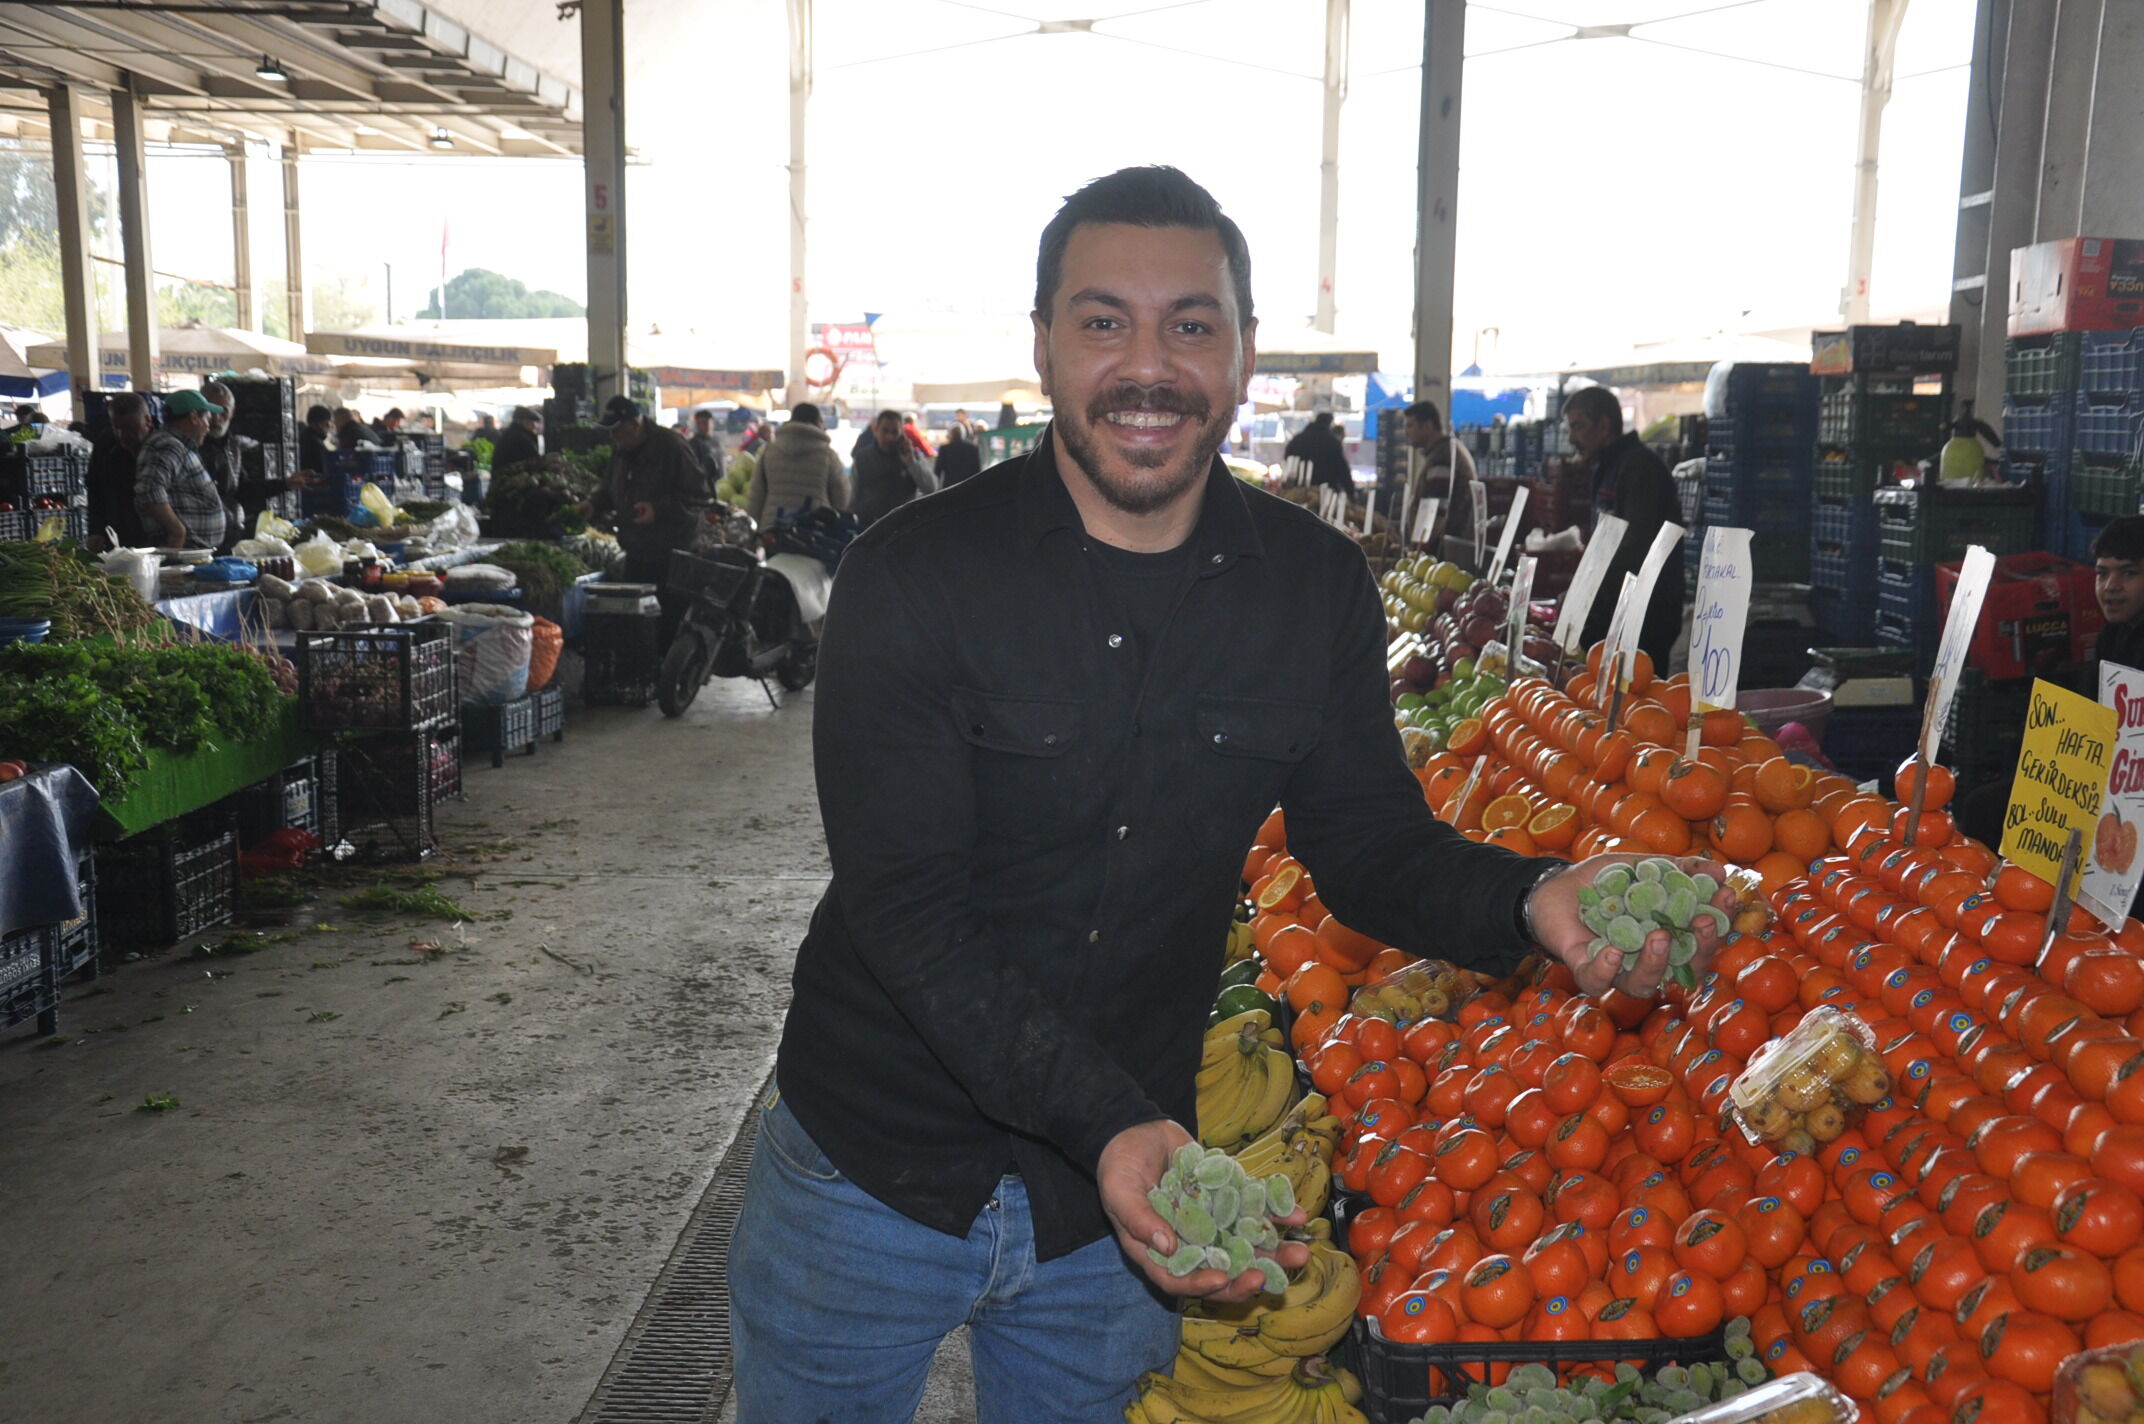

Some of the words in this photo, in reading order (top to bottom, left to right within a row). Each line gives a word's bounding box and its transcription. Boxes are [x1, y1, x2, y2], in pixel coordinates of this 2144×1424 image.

[593, 184, 608, 209] 5
[1857, 279, 1867, 296] 3
[2025, 621, 2068, 634] LUCCA
[1702, 625, 1730, 697] 100
